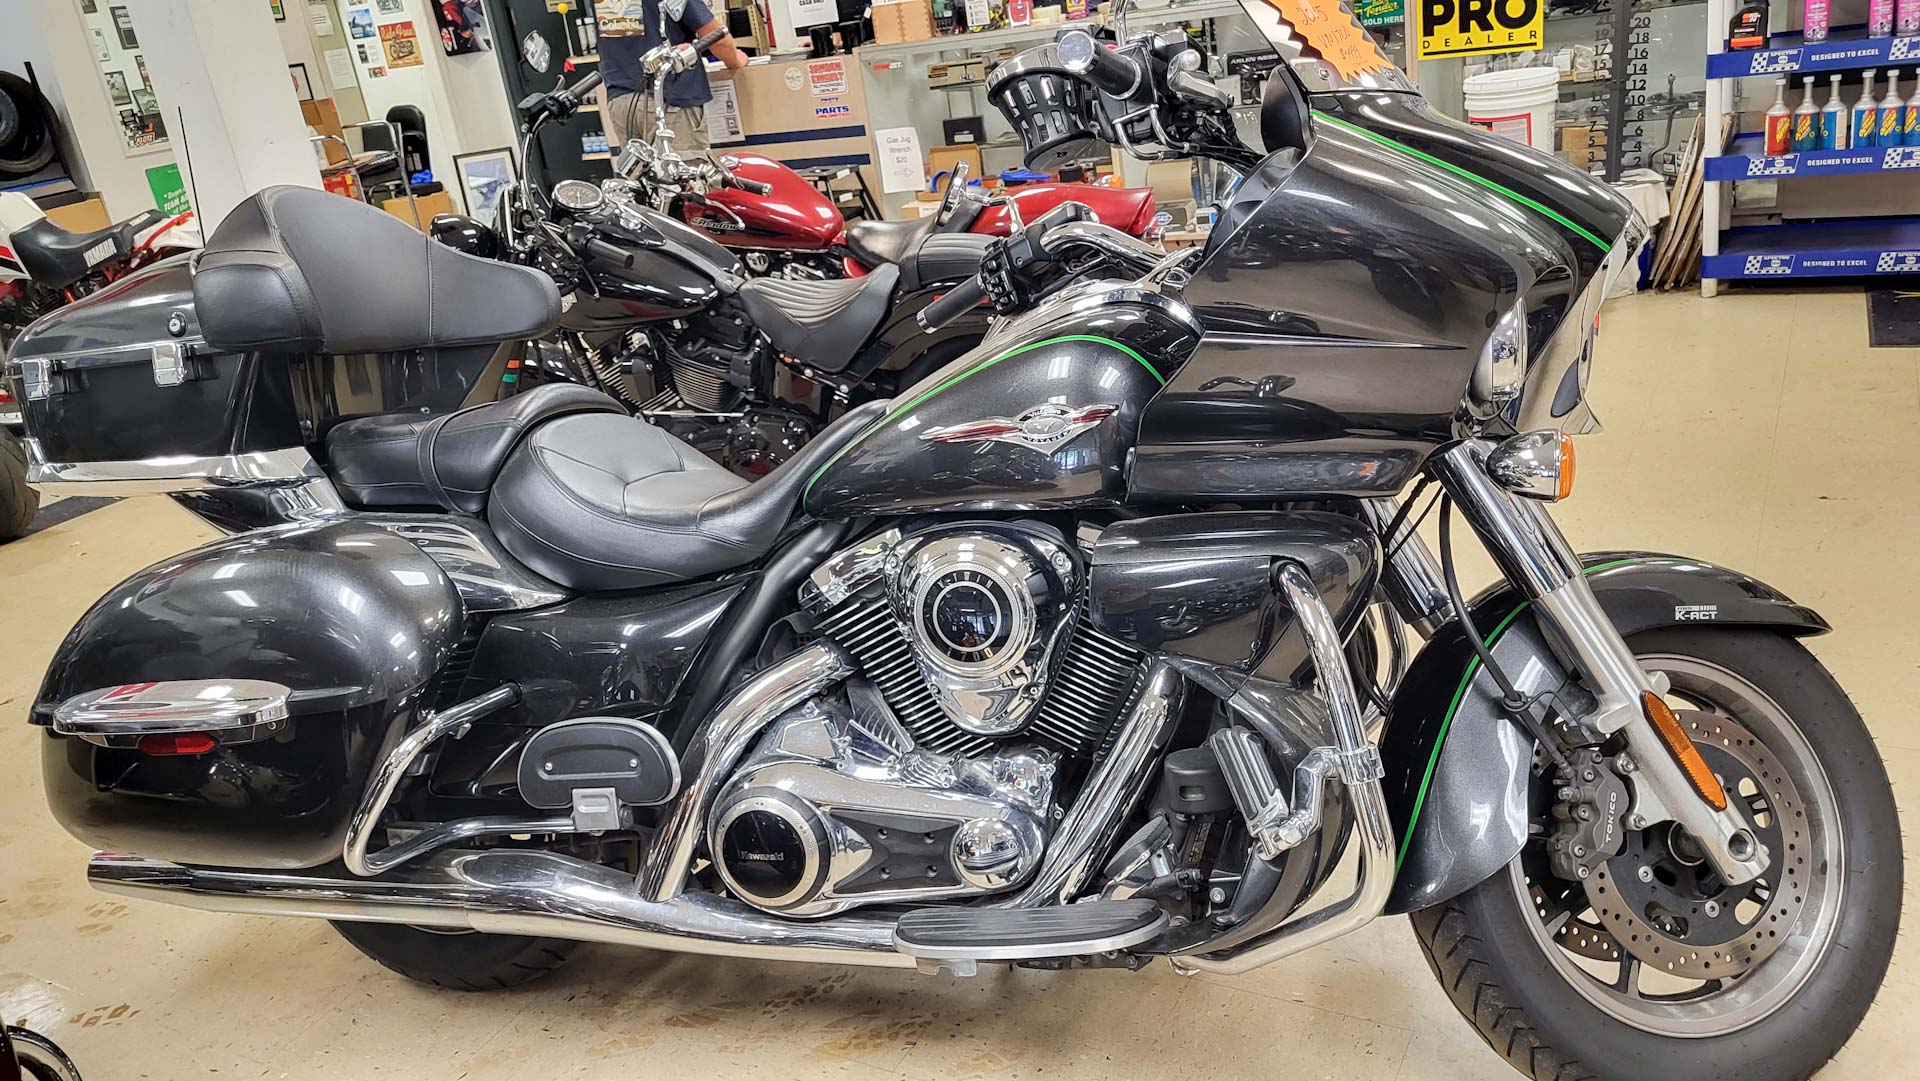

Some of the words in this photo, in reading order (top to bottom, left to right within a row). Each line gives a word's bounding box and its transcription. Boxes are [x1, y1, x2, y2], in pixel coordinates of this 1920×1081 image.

[1364, 1, 1398, 18] Tender
[1363, 17, 1382, 26] SOLD
[1384, 14, 1404, 24] HERE
[1422, 0, 1538, 37] PRO
[1634, 16, 1651, 28] 20
[599, 19, 640, 31] Columbia
[1423, 30, 1538, 49] DEALER
[1635, 32, 1650, 43] 18
[1594, 44, 1608, 56] 17
[1633, 47, 1649, 59] 16
[1811, 51, 1846, 61] DESIGNED
[1847, 50, 1857, 58] TO
[1857, 48, 1879, 57] EXCEL
[1230, 56, 1256, 65] ARLEN
[1257, 53, 1279, 61] NESS
[1594, 59, 1606, 70] 15
[1632, 63, 1647, 74] 14
[1632, 79, 1646, 90] 12
[1631, 94, 1646, 106] 10
[815, 105, 849, 115] PARTS
[1637, 110, 1645, 121] 8
[1635, 125, 1643, 136] 6
[886, 136, 899, 144] Gas
[900, 136, 911, 144] Jug
[1589, 135, 1596, 146] 5
[1634, 141, 1643, 151] 4
[896, 156, 908, 164] $20
[1634, 156, 1642, 166] 2
[1807, 159, 1841, 167] DESIGNED
[1842, 157, 1851, 165] TO
[1852, 156, 1873, 164] EXCEL
[691, 216, 739, 231] Shadow
[83, 237, 118, 268] YAMAHA
[1803, 260, 1836, 268] DESIGNED
[1837, 259, 1846, 267] TO
[1846, 259, 1868, 267] EXCEL
[936, 571, 994, 590] V-TWIN
[1675, 610, 1718, 620] K-ACT
[946, 646, 994, 662] 1700
[1605, 791, 1617, 844] TOKICO
[741, 850, 784, 861] Kawasaki
